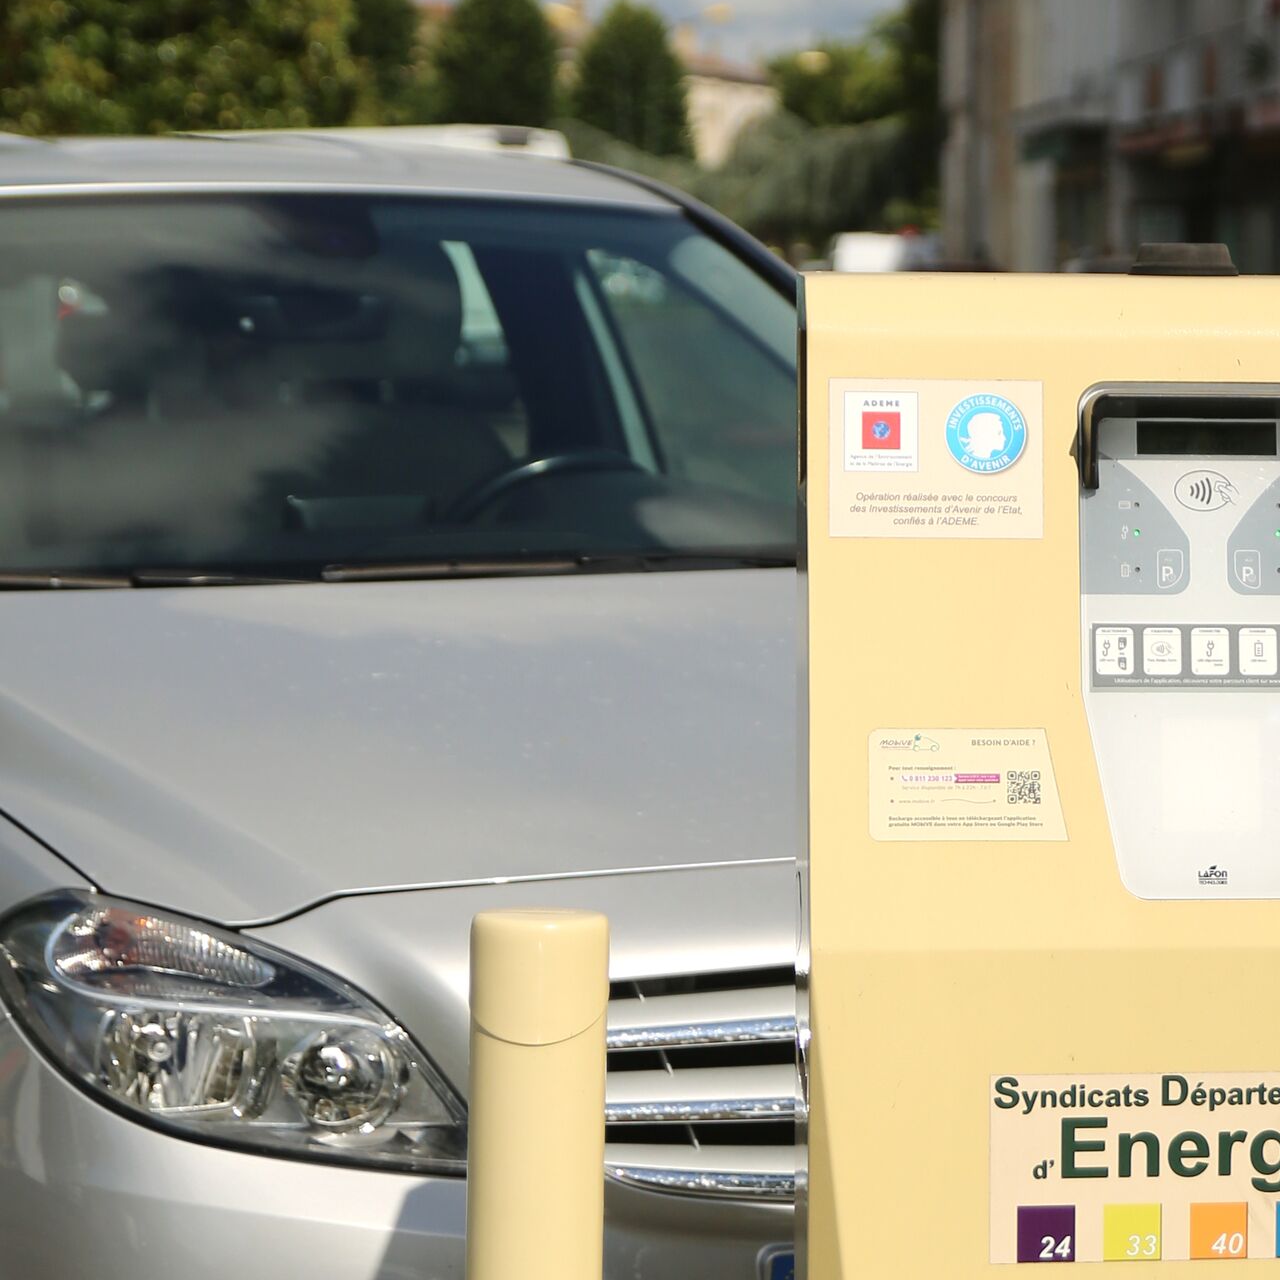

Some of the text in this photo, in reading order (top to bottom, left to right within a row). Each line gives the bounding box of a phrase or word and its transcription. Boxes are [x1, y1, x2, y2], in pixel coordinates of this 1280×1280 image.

[863, 399, 900, 407] ADEME
[949, 395, 1023, 431] INVESTISSEMENTS
[961, 454, 1011, 470] D'AVENIR
[855, 492, 1018, 504] Opération réalisée avec le concours
[849, 504, 866, 513] des
[869, 504, 942, 514] Investissements
[944, 505, 983, 514] d'Avenir
[984, 505, 995, 514] de
[893, 516, 926, 526] confiés
[928, 516, 934, 526] à
[994, 1075, 1150, 1114] Syndicats
[1039, 1236, 1072, 1259] 24
[1126, 1234, 1157, 1257] 33
[1211, 1232, 1243, 1255] 40
